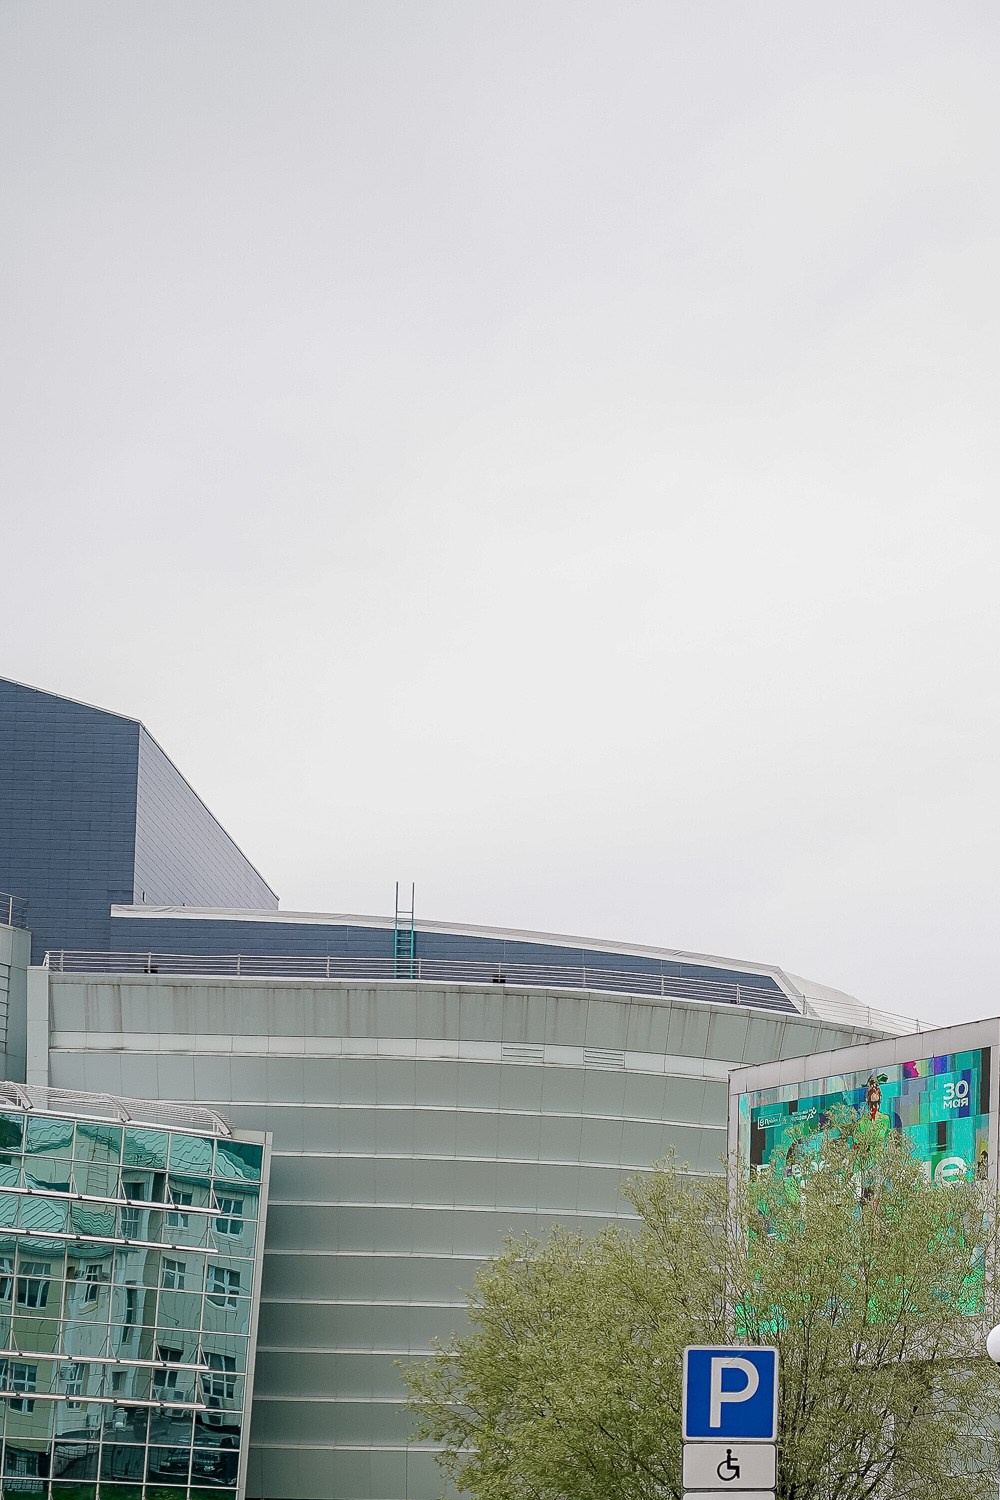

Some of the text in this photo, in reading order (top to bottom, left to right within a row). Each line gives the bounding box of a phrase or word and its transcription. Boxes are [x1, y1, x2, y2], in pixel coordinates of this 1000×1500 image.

[943, 1080, 969, 1101] 30
[943, 1097, 969, 1109] мая
[709, 1356, 760, 1428] P
